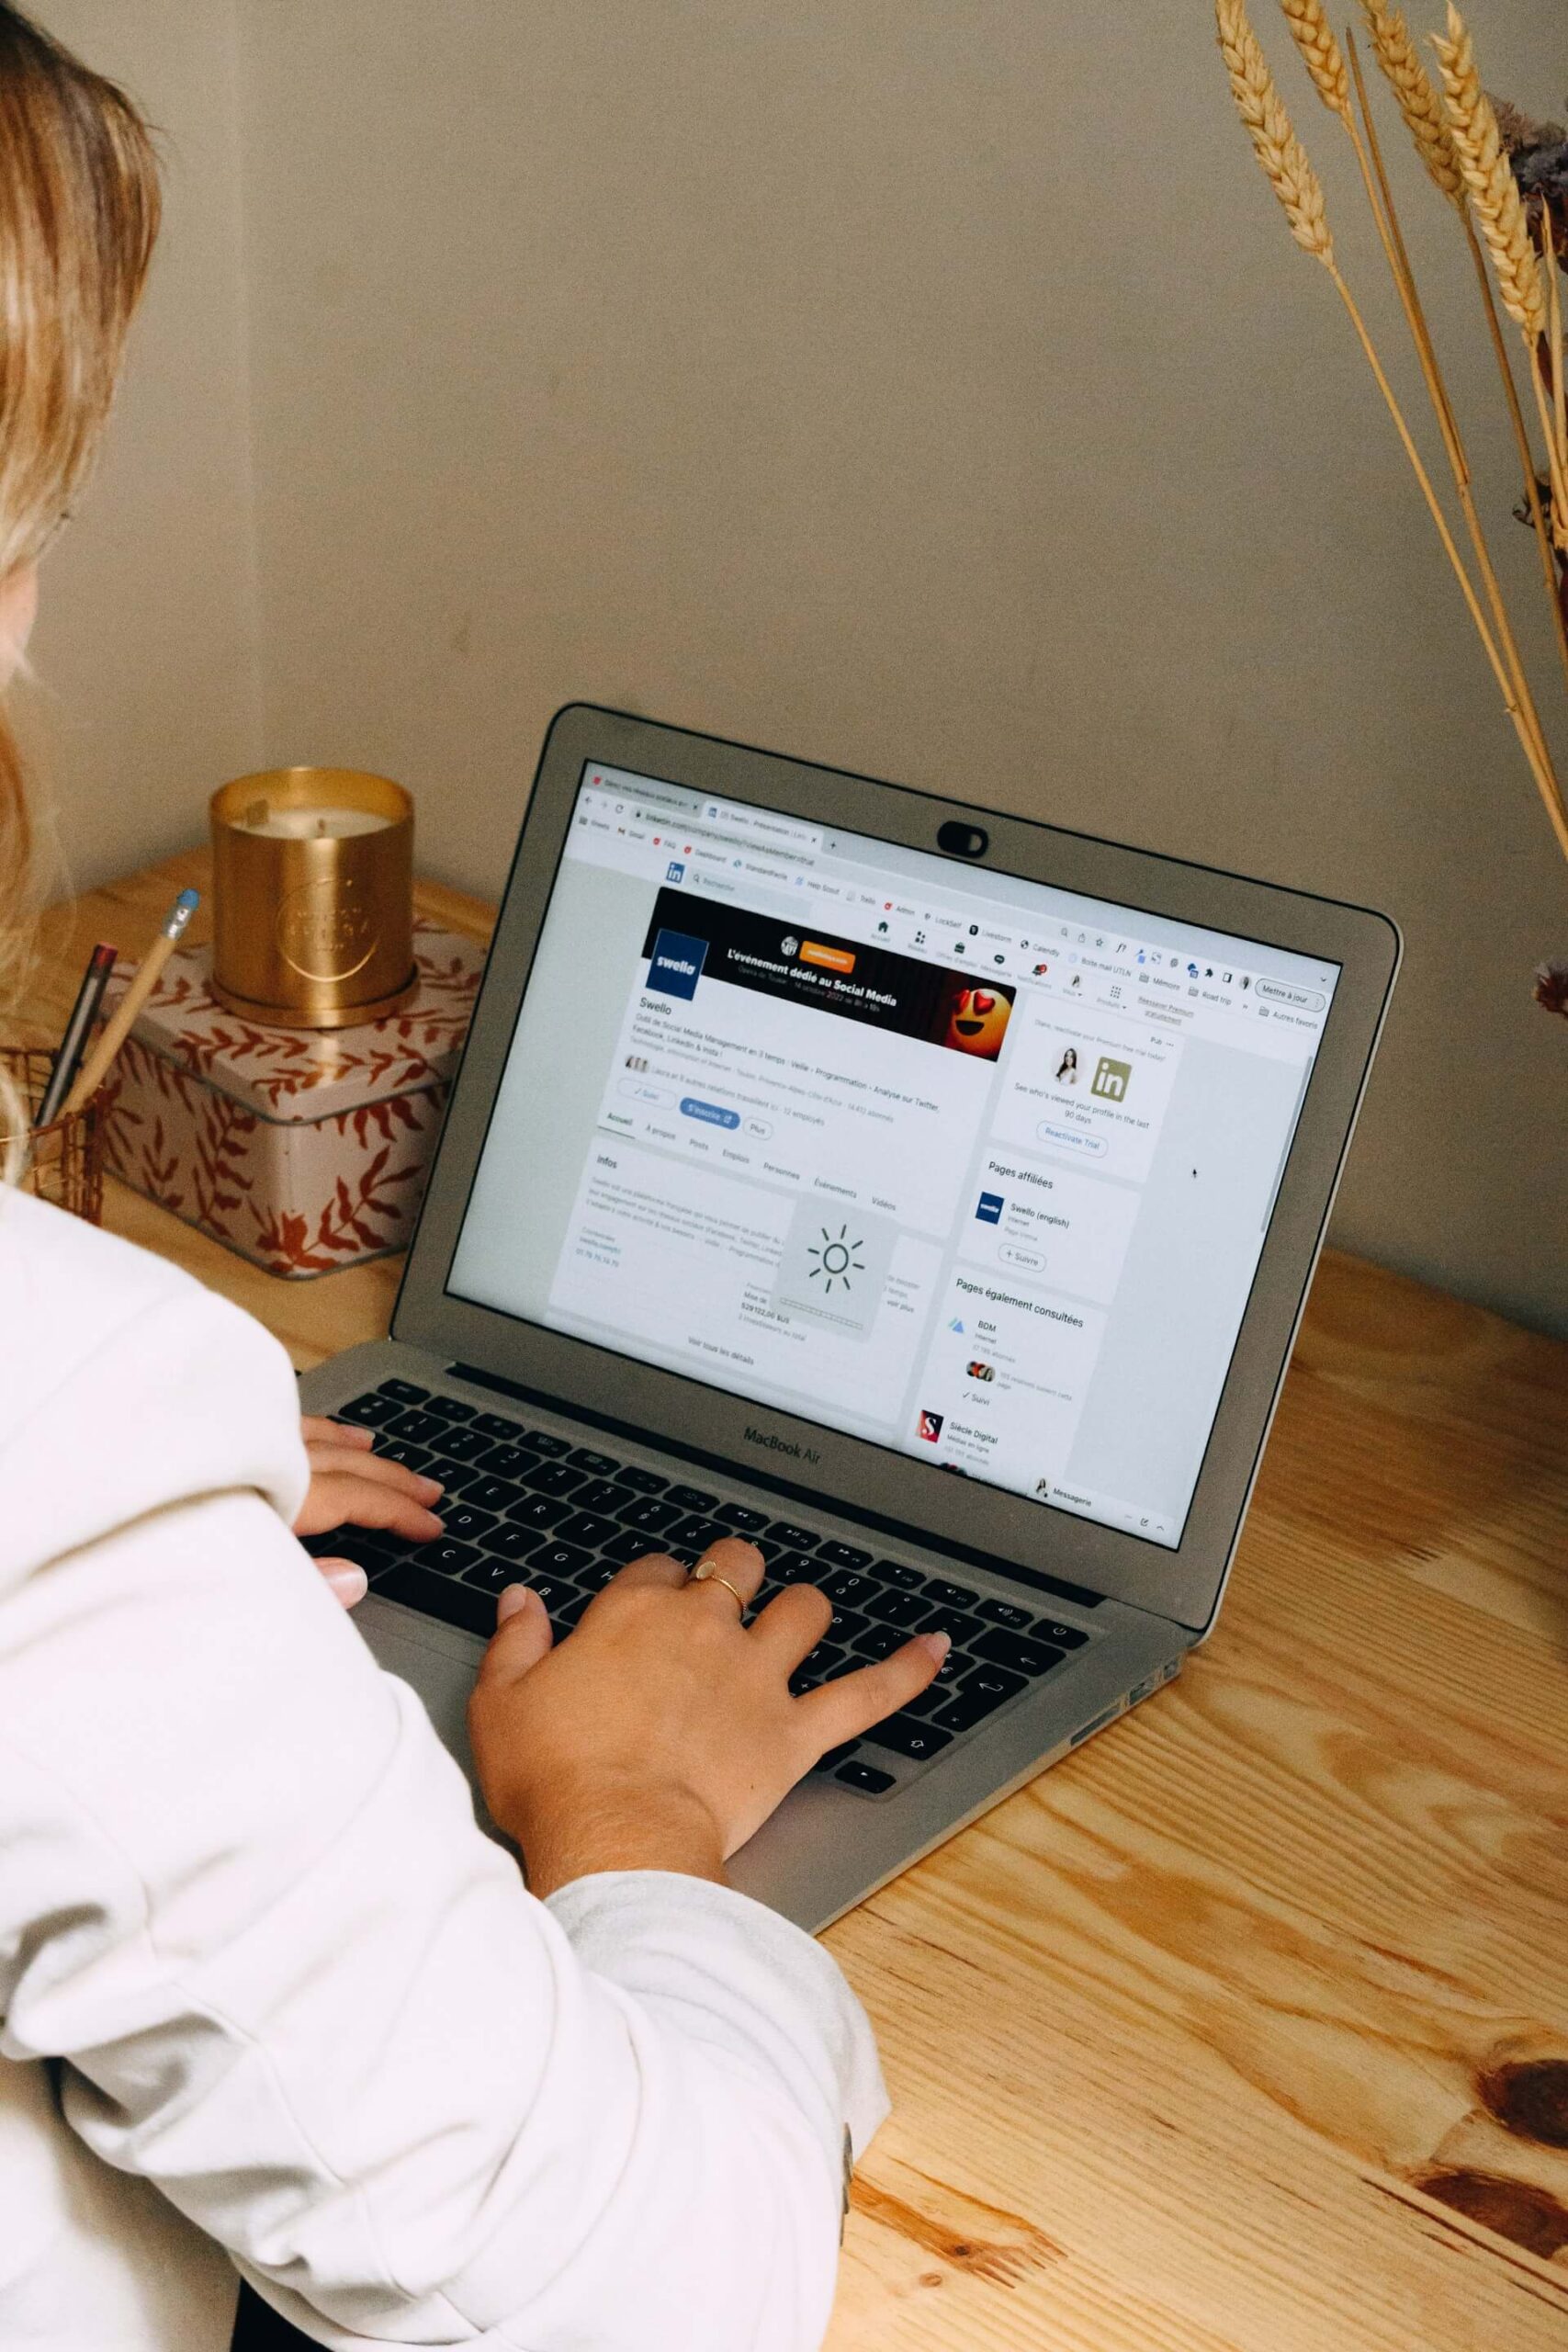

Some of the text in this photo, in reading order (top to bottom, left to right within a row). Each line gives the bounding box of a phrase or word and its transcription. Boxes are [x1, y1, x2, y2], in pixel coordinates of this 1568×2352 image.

[627, 829, 645, 842] Gmail
[663, 839, 677, 851] FAQ
[694, 847, 727, 865] Dashboard
[807, 879, 840, 897] Help Scout
[859, 894, 876, 906] Trello
[895, 903, 916, 917] Admin
[934, 914, 962, 930] LockSelf
[980, 927, 1012, 944] Livestorm
[1032, 942, 1060, 958] Calendly
[656, 953, 696, 977] swello
[1098, 960, 1133, 978] mail UTLN
[727, 947, 789, 976] L'événement
[789, 966, 818, 984] dédié
[818, 976, 832, 988] au
[832, 978, 864, 997] Social
[864, 988, 897, 1007] Media
[1152, 975, 1180, 991] Mémoire
[1201, 989, 1233, 1007] Road trip
[1261, 983, 1287, 999] Mettre
[1292, 991, 1308, 1005] jour
[638, 996, 672, 1016] Swello
[1272, 1009, 1319, 1030] Autres favoris
[1053, 1024, 1081, 1038] reactivate
[1082, 1033, 1094, 1042] your
[1095, 1036, 1121, 1050] Premium
[1149, 1035, 1163, 1046] Pub
[666, 1035, 694, 1050] LinkedIn
[702, 1045, 719, 1057] Insta
[651, 1017, 660, 1028] de
[661, 1021, 682, 1035] Social
[682, 1026, 704, 1041] Media
[703, 1033, 747, 1055] Management
[763, 1051, 786, 1066] temps
[789, 1059, 809, 1073] Veille
[815, 1067, 868, 1091] Programmation
[873, 1084, 901, 1101] Analyse
[900, 1092, 913, 1104] sur
[914, 1096, 941, 1113] Twitter,
[1093, 1059, 1129, 1099] in
[684, 1076, 706, 1090] autres
[706, 1082, 736, 1099] relations
[792, 1109, 825, 1126] employés
[1013, 1082, 1028, 1094] See
[1028, 1087, 1049, 1101] who's
[1049, 1093, 1075, 1108] viewed
[1075, 1101, 1091, 1113] your
[1091, 1105, 1115, 1120] profile
[1122, 1114, 1135, 1125] the
[1135, 1118, 1150, 1130] last
[606, 1112, 633, 1126] Accueil
[1064, 1109, 1092, 1125] 90 days
[650, 1125, 676, 1141] propos
[750, 1124, 765, 1135] Plus
[689, 1137, 709, 1150] Posts
[1044, 1126, 1100, 1150] Reactivate Trial
[595, 1154, 618, 1170] Infos
[721, 1148, 750, 1165] Emplois
[762, 1161, 801, 1181] Personnes
[987, 1160, 1055, 1190] Pages affiliées
[871, 1195, 897, 1211] Vidéos
[1007, 1215, 1030, 1227] Internet
[1010, 1203, 1070, 1229] Swello (english)
[1014, 1251, 1039, 1266] Suivre
[743, 1290, 758, 1301] Mise
[954, 1277, 1085, 1328] Pages également consultées
[886, 1298, 915, 1314] voir plus
[977, 1319, 997, 1332] BDM
[974, 1331, 998, 1345] Internet
[686, 1335, 755, 1366] Voir tous les détails
[970, 1393, 990, 1407] Suivi
[462, 1433, 475, 1442] 2
[949, 1421, 998, 1445] Siècle Digital
[742, 1426, 821, 1465] MacBook Air
[946, 1433, 967, 1447] Médias
[975, 1443, 989, 1454] ligne
[391, 1452, 406, 1461] A
[507, 1451, 522, 1460] 3
[438, 1469, 455, 1478] Z
[555, 1469, 567, 1477] 4
[485, 1486, 500, 1496] E
[602, 1487, 615, 1496] 5
[1052, 1487, 1092, 1508] Messagerie
[532, 1504, 547, 1514] R
[649, 1505, 662, 1513] 6
[457, 1514, 473, 1524] D
[699, 1521, 712, 1530] 7
[581, 1522, 595, 1532] T
[505, 1532, 521, 1542] F
[630, 1541, 645, 1551] Y
[441, 1549, 457, 1559] C
[553, 1552, 570, 1562] G
[797, 1558, 810, 1567] 9
[490, 1567, 506, 1577] V
[600, 1570, 615, 1580] H
[847, 1577, 861, 1587] 0
[536, 1586, 553, 1597] B
